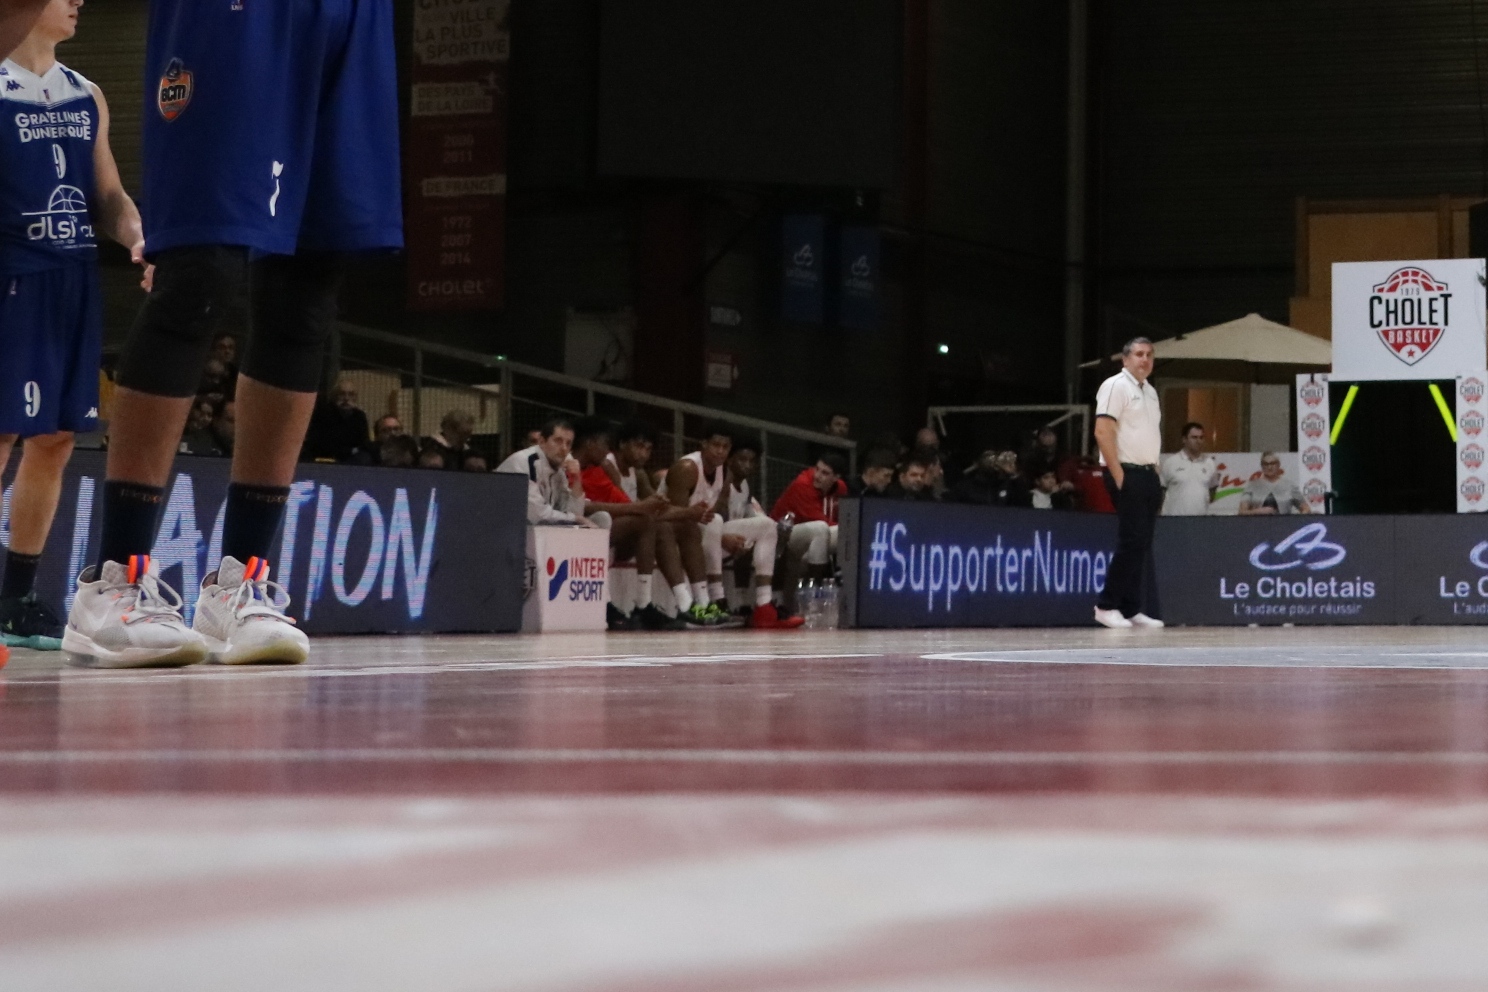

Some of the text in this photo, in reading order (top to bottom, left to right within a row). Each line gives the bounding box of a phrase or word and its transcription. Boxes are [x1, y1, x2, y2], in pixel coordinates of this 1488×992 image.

[450, 7, 496, 24] VILLE
[416, 23, 483, 43] LA PLUS
[426, 39, 507, 59] SPORTIVE
[52, 143, 67, 180] 9
[1369, 292, 1452, 330] CHOLET
[1388, 329, 1436, 344] BASKET
[24, 380, 41, 419] 9
[570, 557, 605, 579] INTER
[569, 580, 604, 602] SPORT
[1220, 576, 1376, 599] Le Choletais
[1439, 576, 1470, 599] Le
[1233, 602, 1362, 616] L'audace pour réussir
